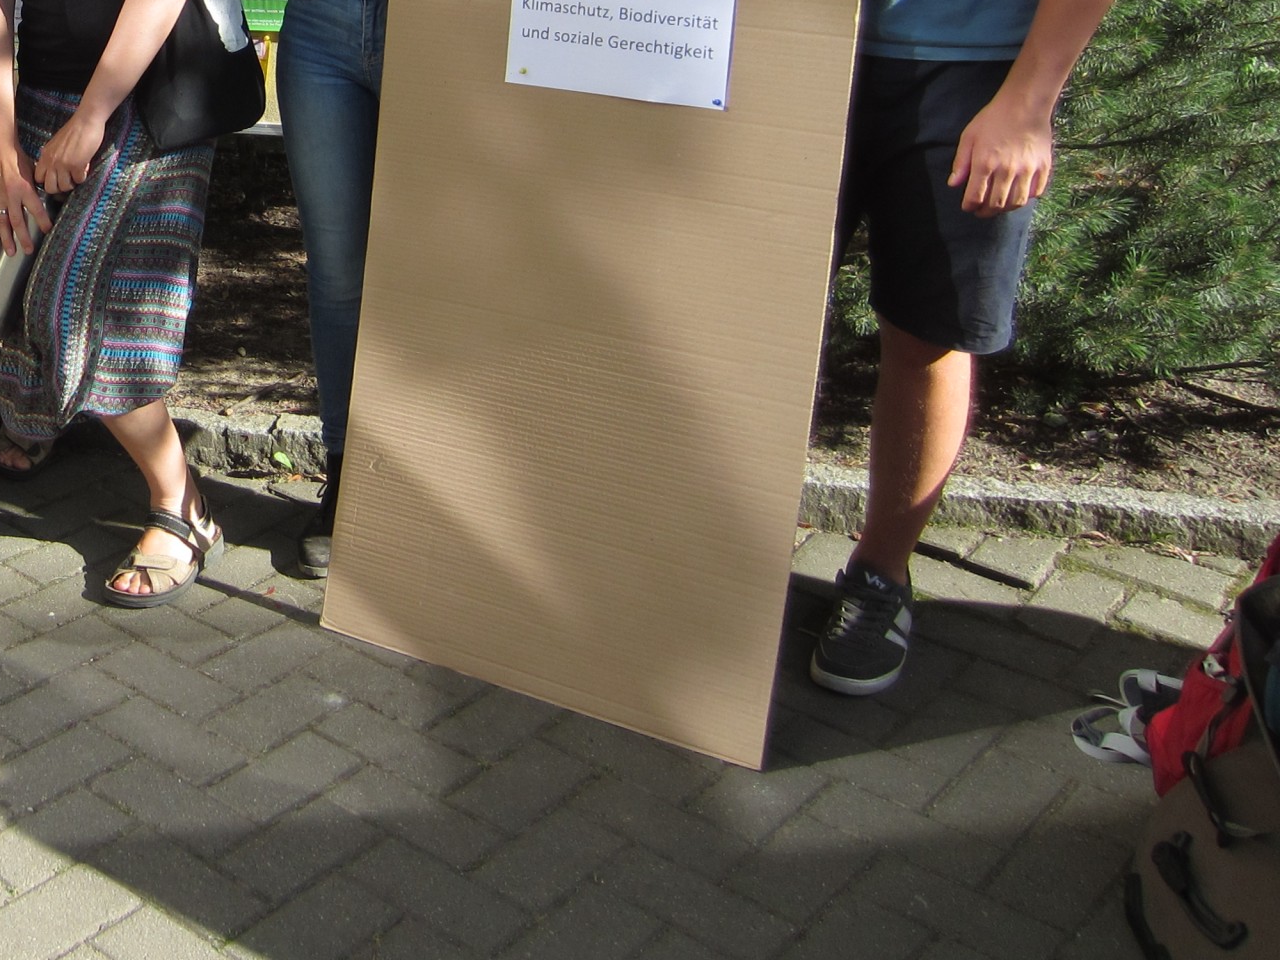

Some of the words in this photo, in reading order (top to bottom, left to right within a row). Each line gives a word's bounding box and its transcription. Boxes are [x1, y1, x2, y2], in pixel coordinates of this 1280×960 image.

[619, 7, 719, 31] Biodiversität
[521, 26, 550, 40] und
[554, 30, 604, 47] soziale
[608, 35, 714, 60] Gerechtigkeit
